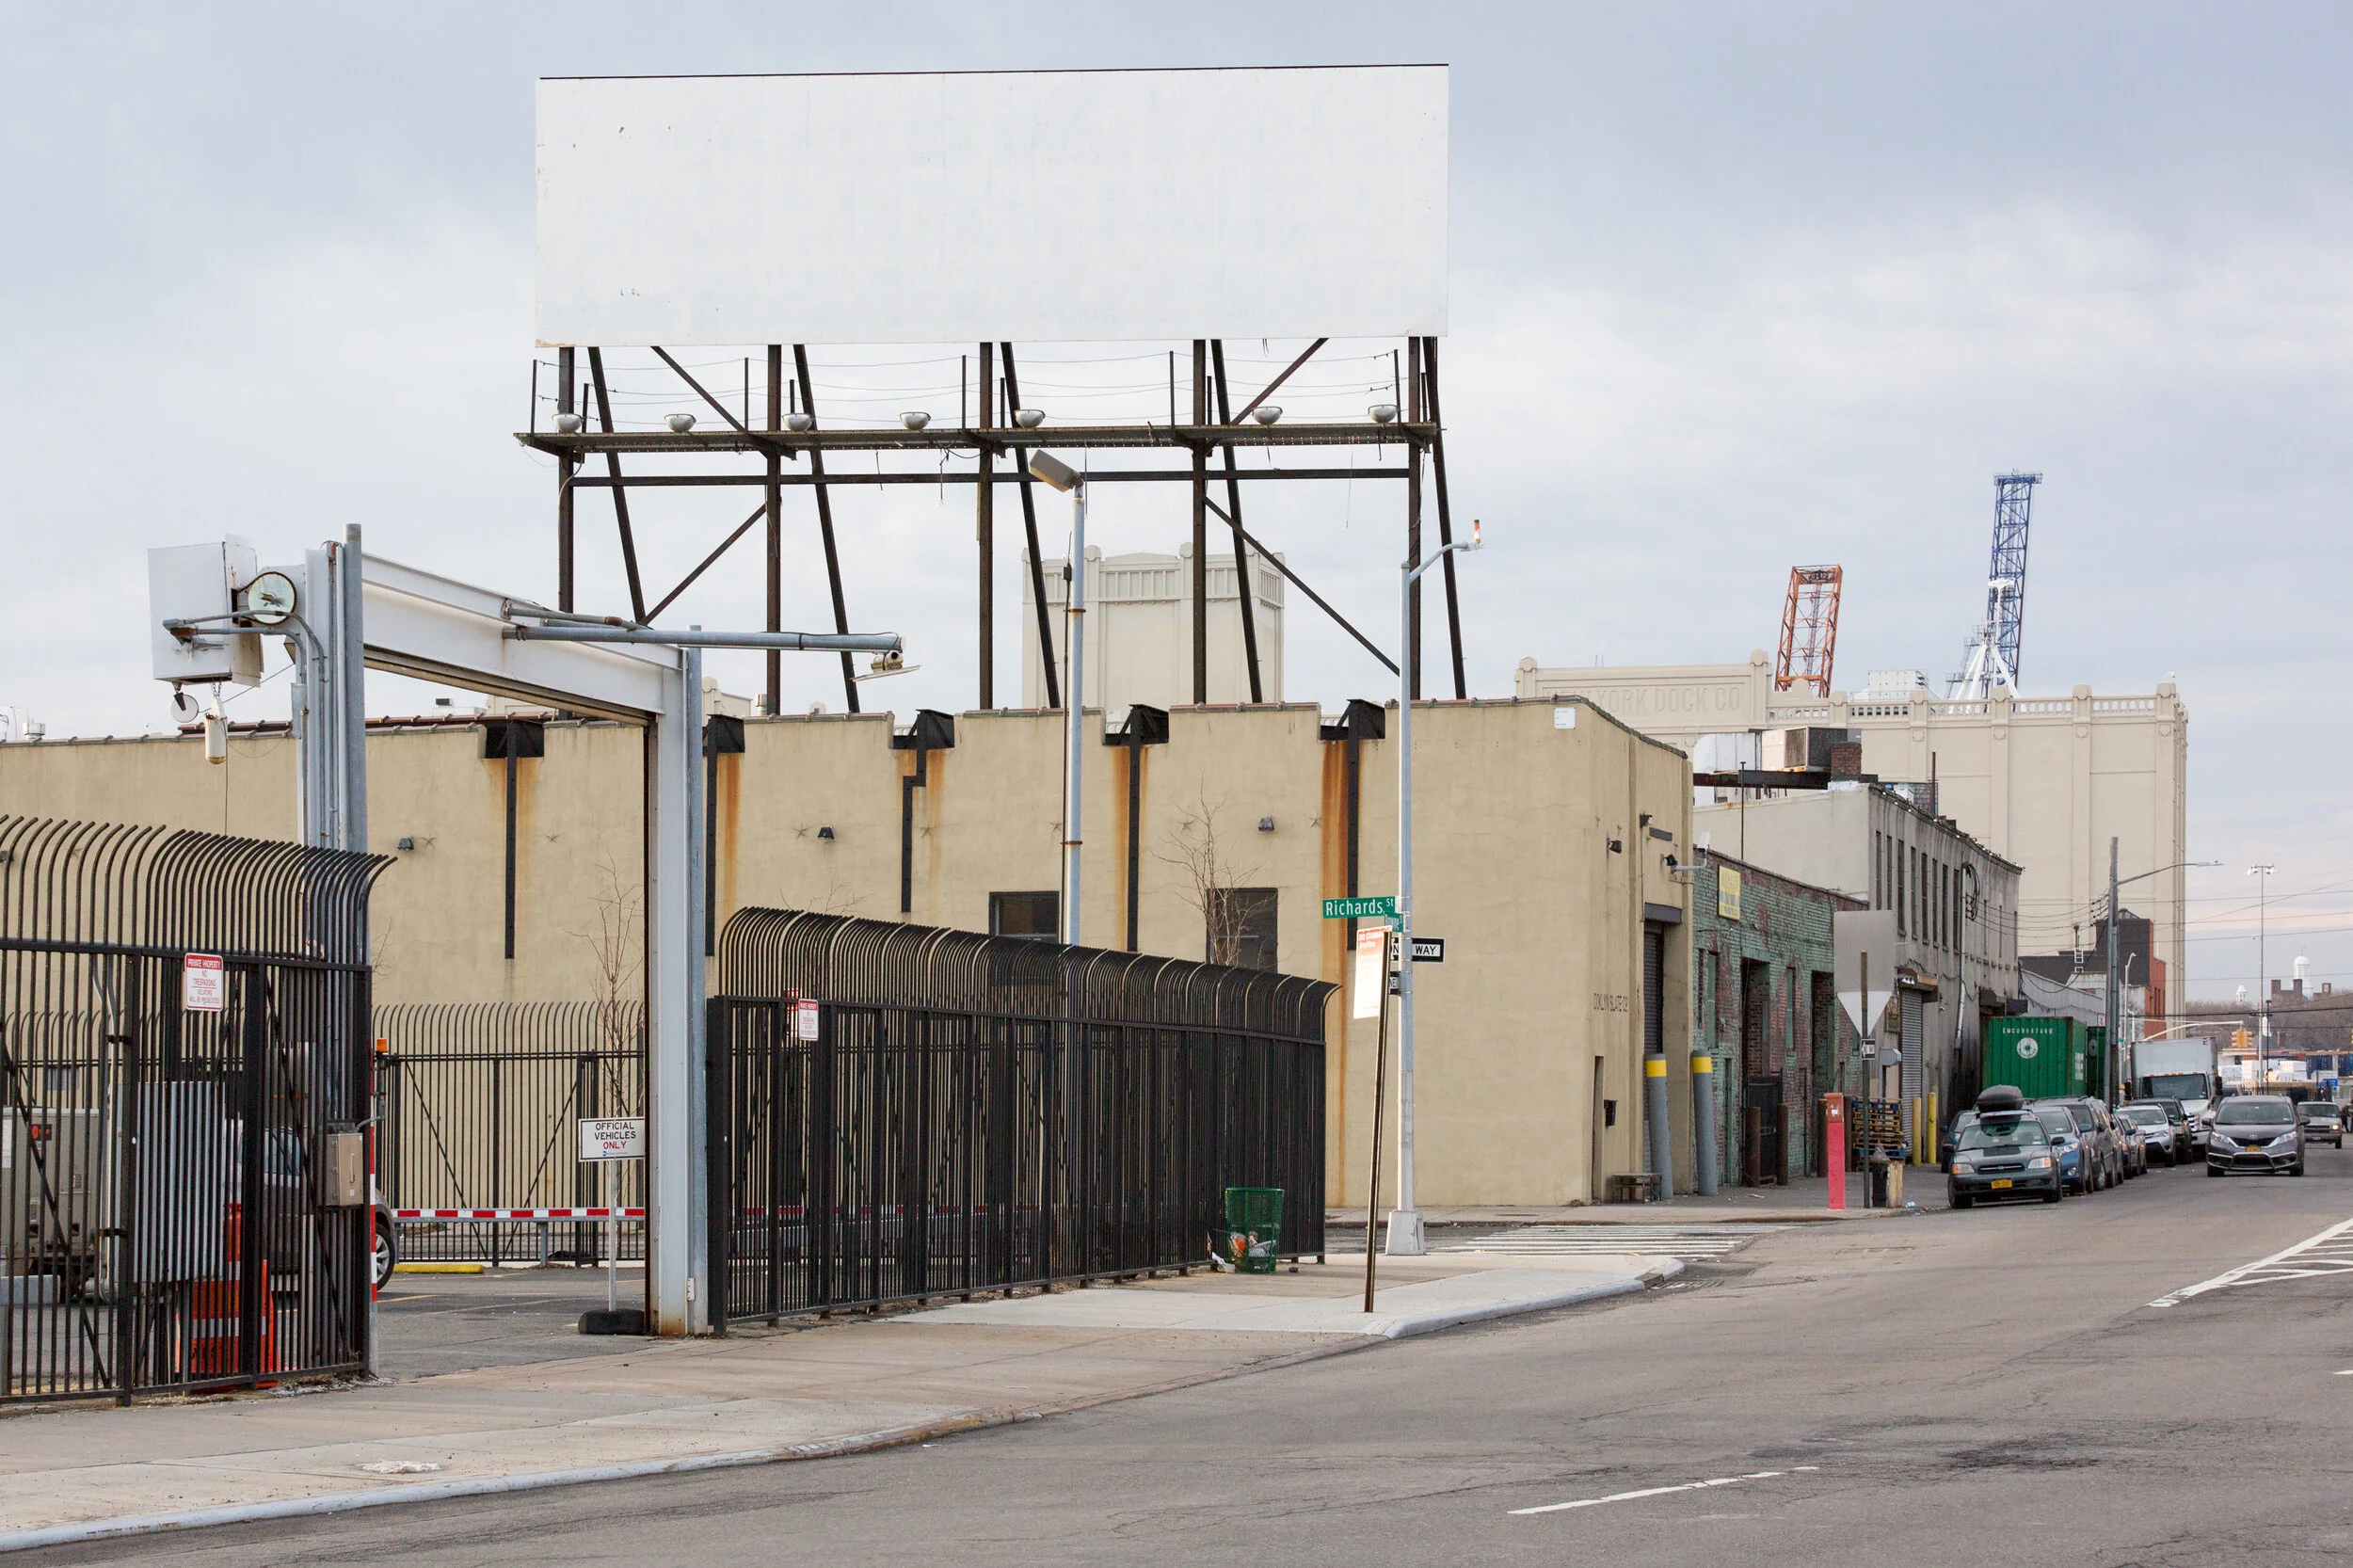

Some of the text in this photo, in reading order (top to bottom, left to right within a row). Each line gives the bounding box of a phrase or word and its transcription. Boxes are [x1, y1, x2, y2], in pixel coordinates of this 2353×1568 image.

[1597, 686, 1740, 713] YORK DOCK CO
[1325, 898, 1394, 916] Richards St
[1415, 945, 1436, 955] WAY
[188, 958, 221, 969] PRIVATE PROPERTY
[201, 969, 208, 978] NO
[193, 978, 216, 987] TRESPASSING
[595, 1121, 634, 1131] OFFICIAL
[594, 1130, 636, 1141] VEHICLES
[602, 1141, 627, 1150] ONLY
